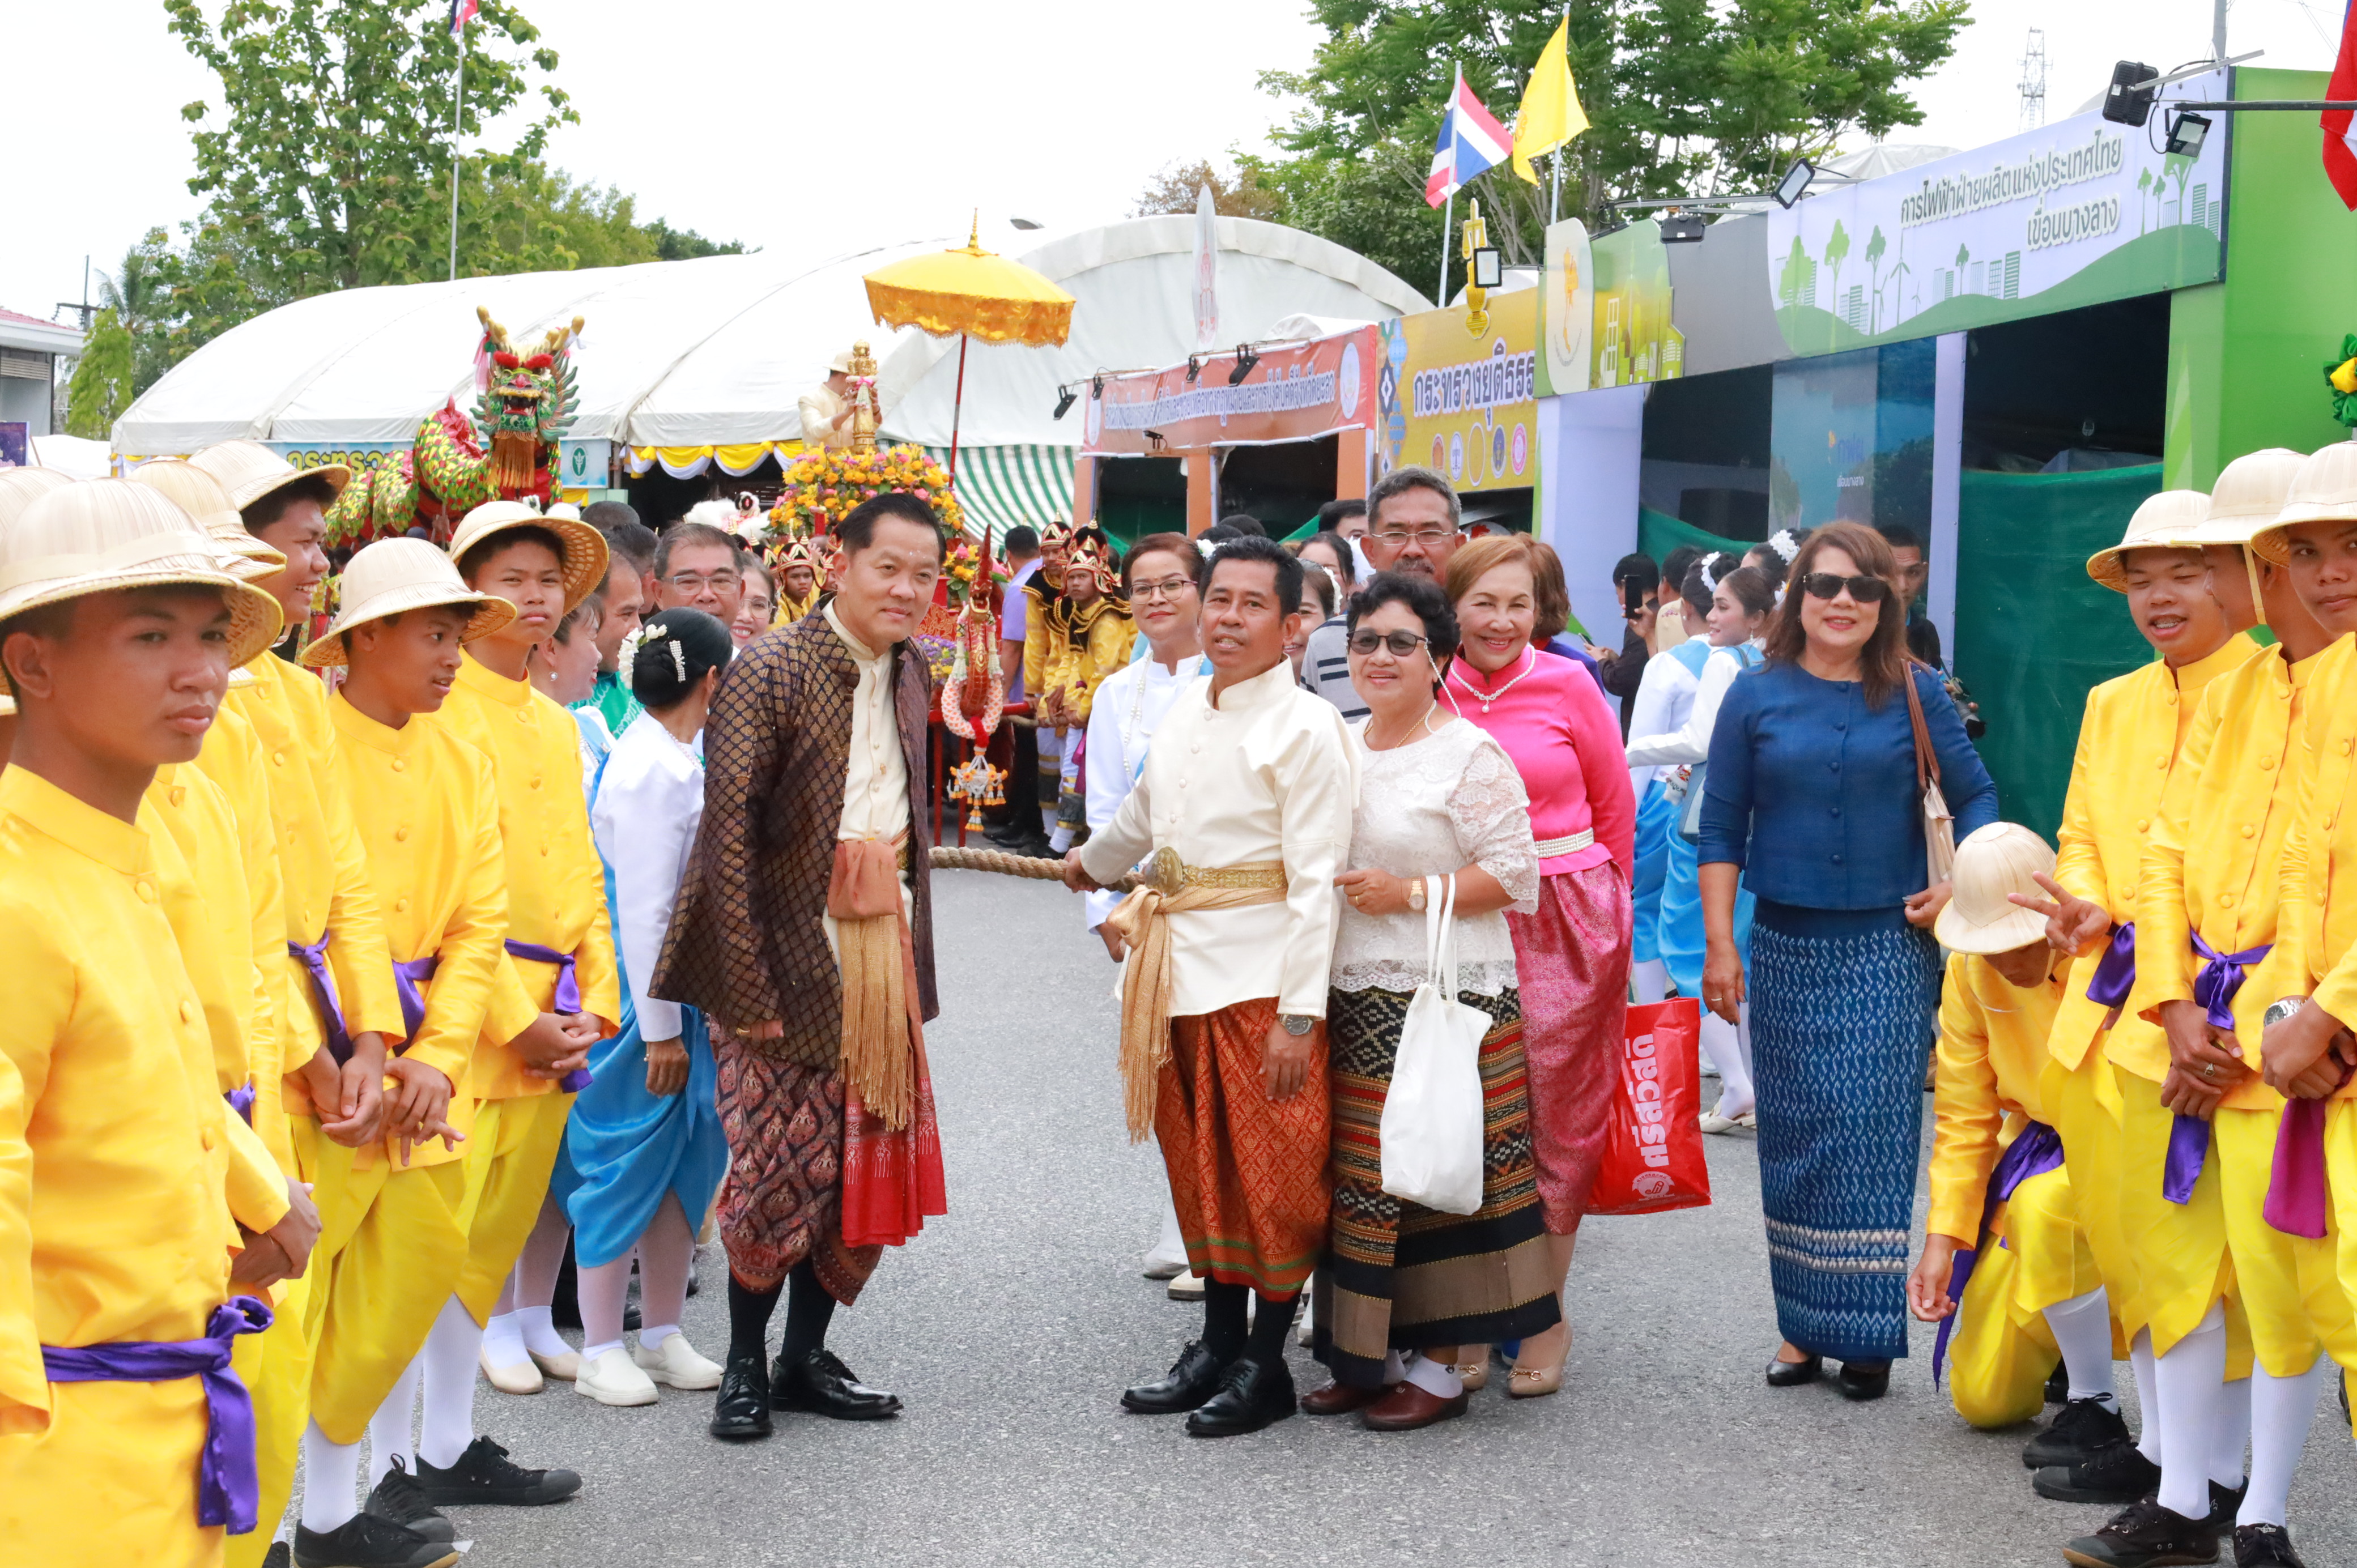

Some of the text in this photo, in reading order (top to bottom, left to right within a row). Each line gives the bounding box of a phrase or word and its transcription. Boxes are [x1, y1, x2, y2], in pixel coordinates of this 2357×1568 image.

[1901, 129, 2121, 224] การไฟฟ้าฝ่ายผลิตแห่งประเทศไทย
[2027, 196, 2118, 246] เขื่อนบางลาง
[1415, 342, 1535, 426] กระทรวงยุติธรร
